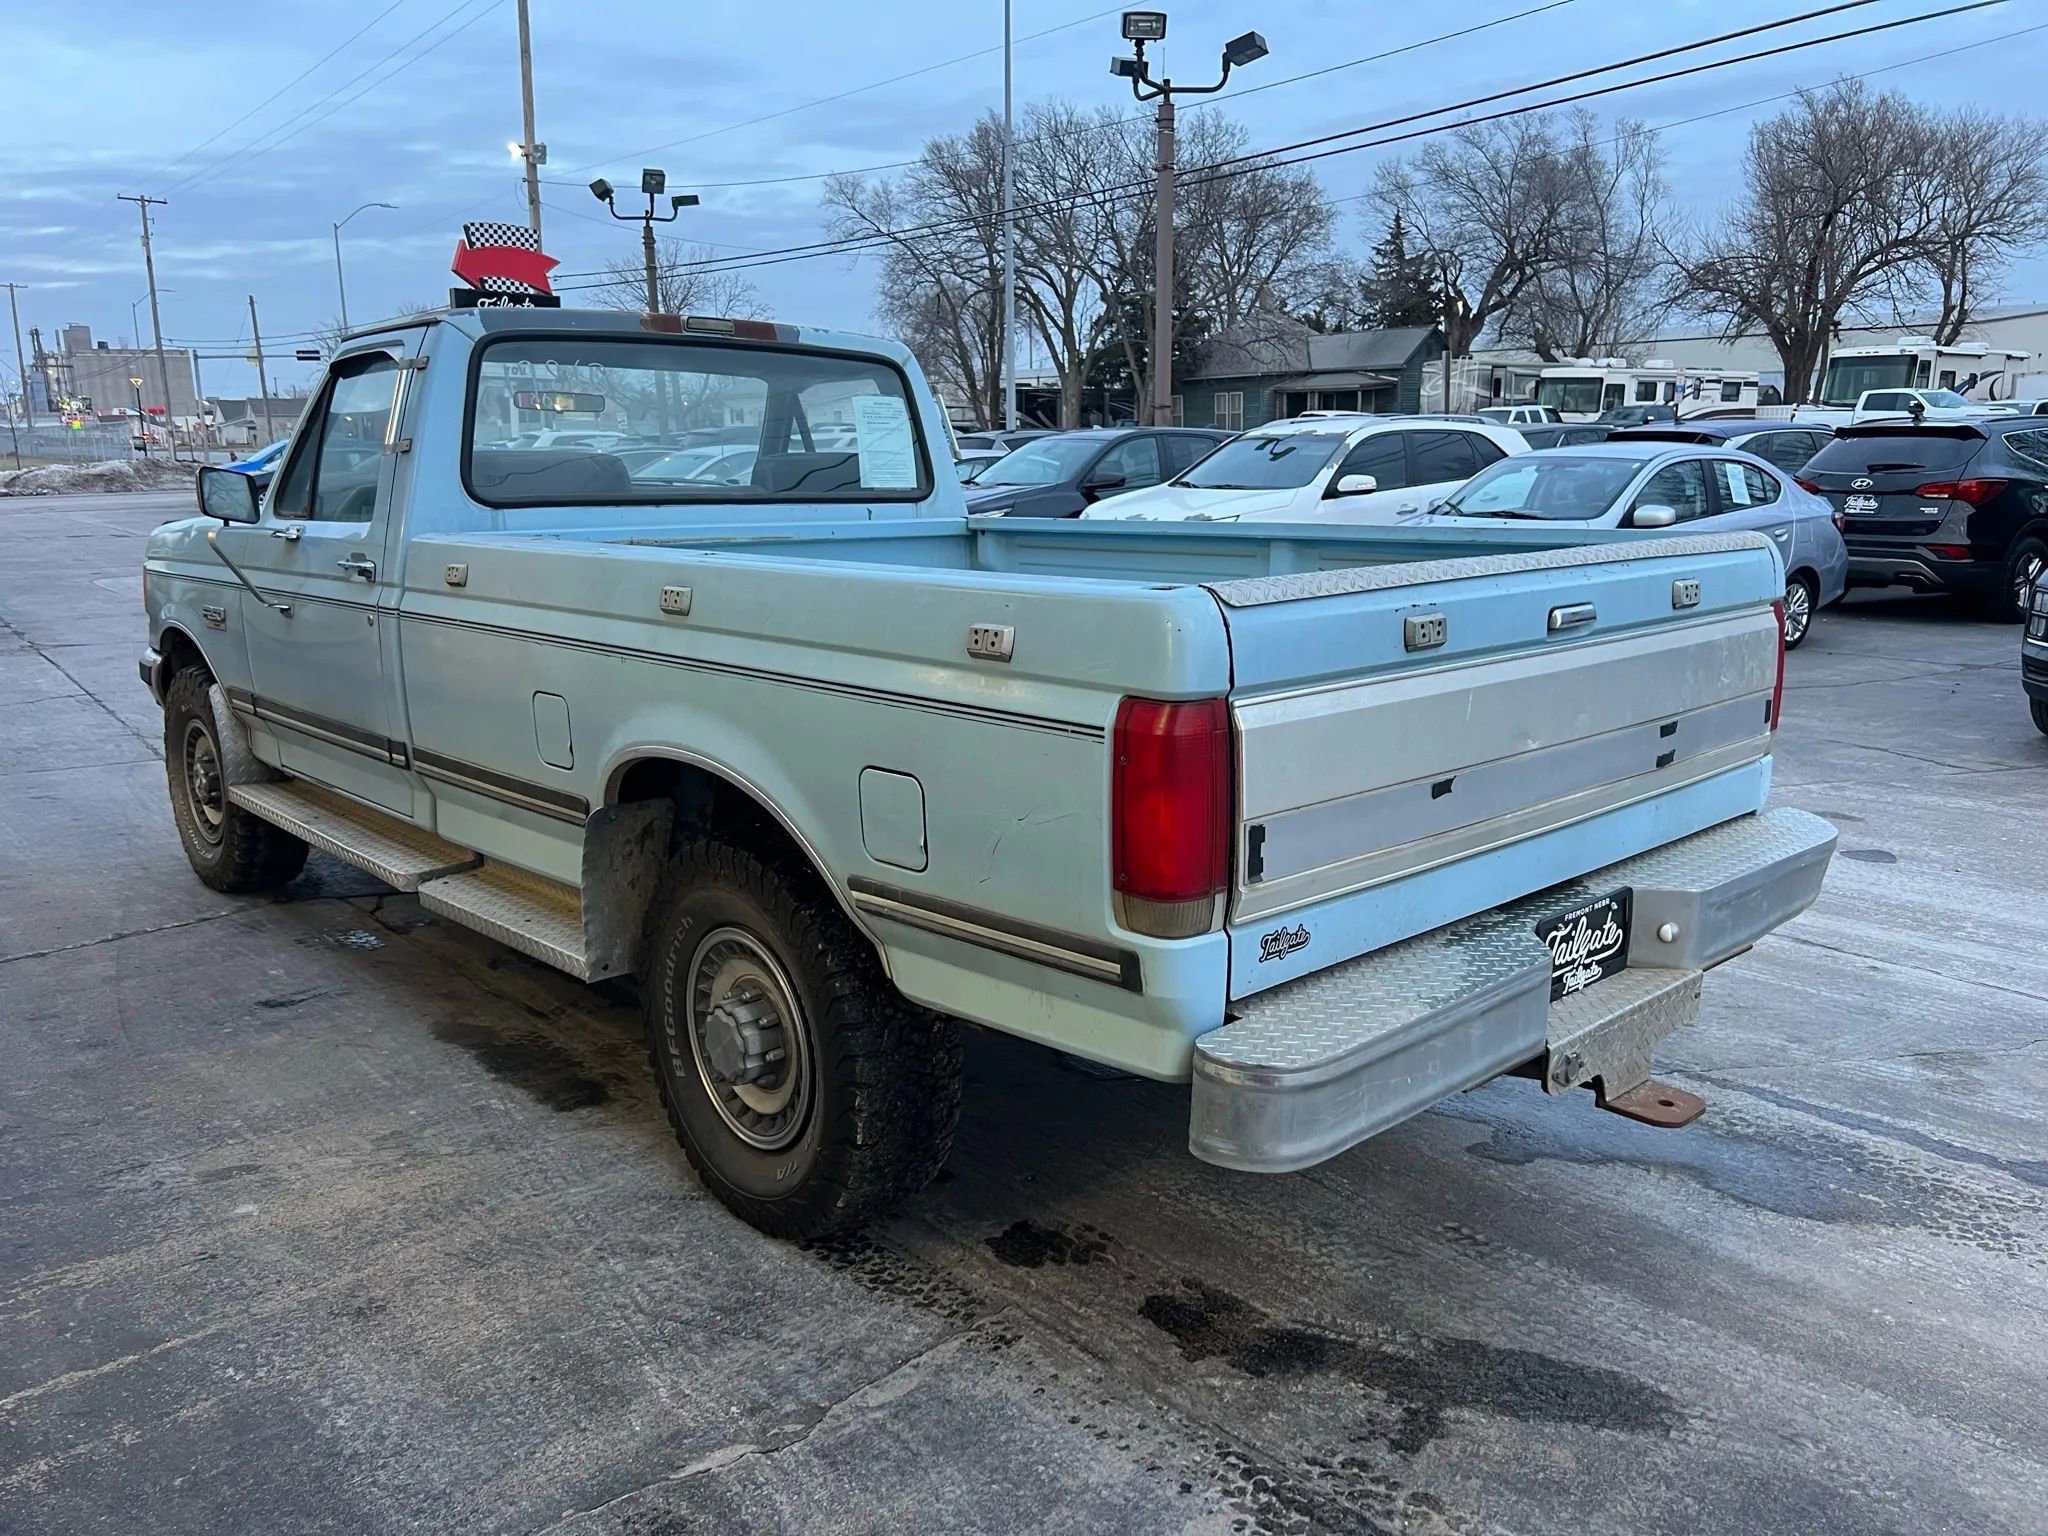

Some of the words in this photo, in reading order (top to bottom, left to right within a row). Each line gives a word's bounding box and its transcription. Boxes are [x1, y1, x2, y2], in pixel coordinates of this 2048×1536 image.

[1564, 904, 1593, 921] FREMONT
[1259, 924, 1311, 962] Tailgate
[1546, 911, 1623, 977] Tailgate
[664, 915, 693, 1078] BFGoodrich
[1562, 961, 1602, 994] Tailgate
